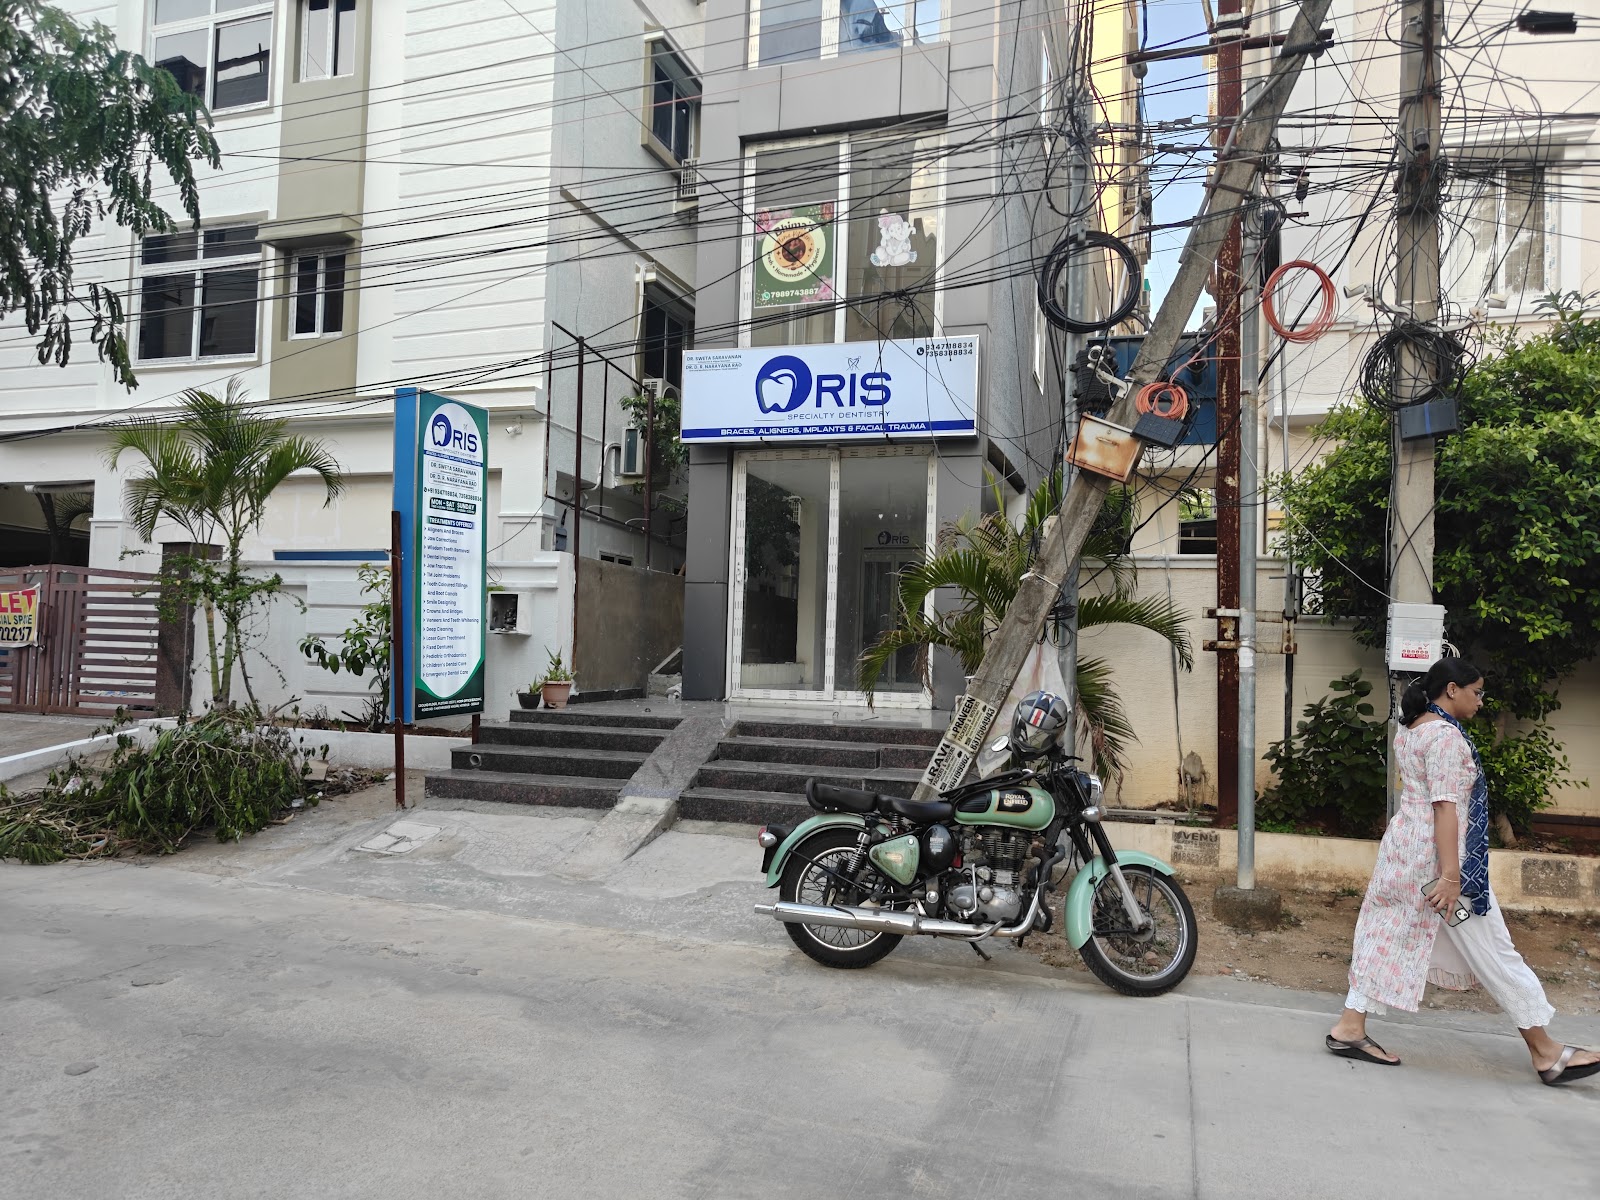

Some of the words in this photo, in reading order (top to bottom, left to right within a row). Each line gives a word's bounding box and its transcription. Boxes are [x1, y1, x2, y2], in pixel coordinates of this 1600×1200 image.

[775, 268, 804, 278] Homemade
[770, 288, 819, 298] 7989743887
[788, 412, 835, 420] SPECIALTY
[838, 410, 890, 419] DENTISTRY
[758, 428, 802, 436] ALIGNERS,
[453, 466, 477, 476] SARAVANAN
[447, 476, 468, 485] NARAYANA
[430, 517, 455, 526] TREATMENTS
[952, 696, 976, 734] PRAVEEN
[958, 724, 969, 741] PACKERS
[928, 743, 951, 777] RAVI
[933, 768, 944, 786] PACKERS
[1004, 799, 1028, 807] ENFIELD
[1183, 832, 1217, 842] VENU
